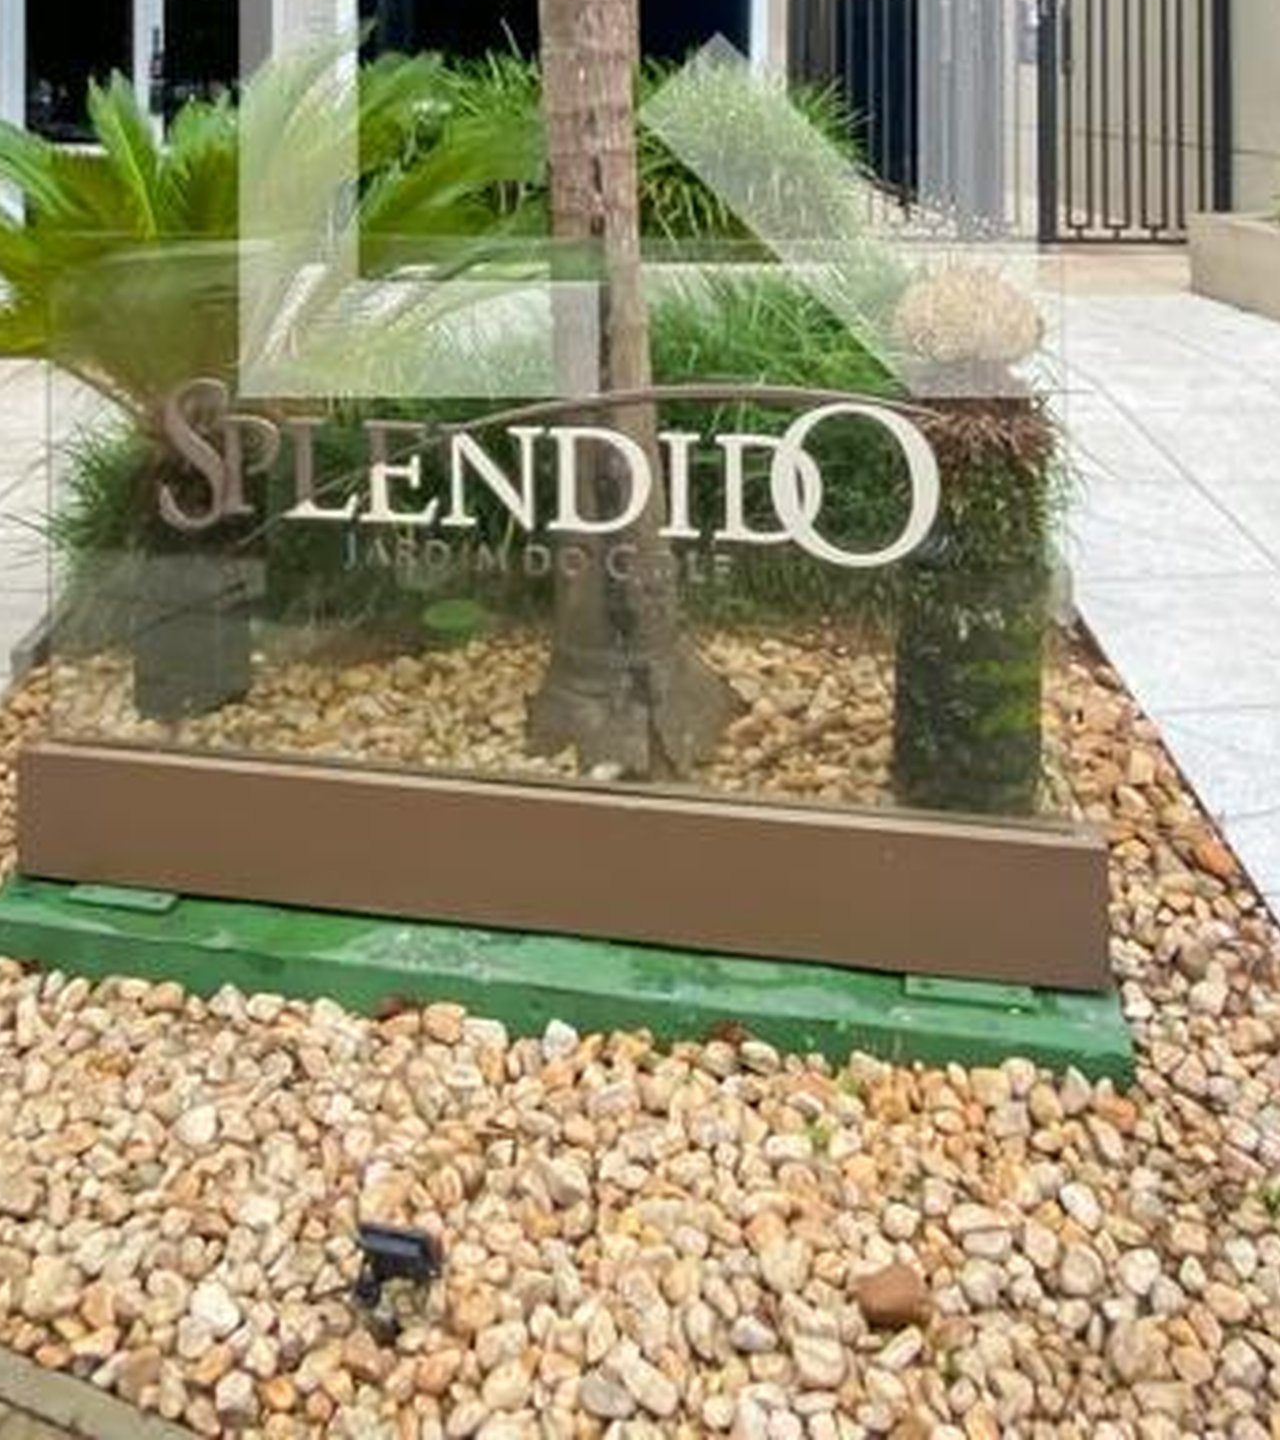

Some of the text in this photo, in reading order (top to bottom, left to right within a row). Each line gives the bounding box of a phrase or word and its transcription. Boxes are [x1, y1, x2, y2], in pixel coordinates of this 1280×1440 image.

[157, 376, 942, 568] SPLENDIDO
[521, 543, 589, 577] DO
[604, 544, 735, 584] GLF
